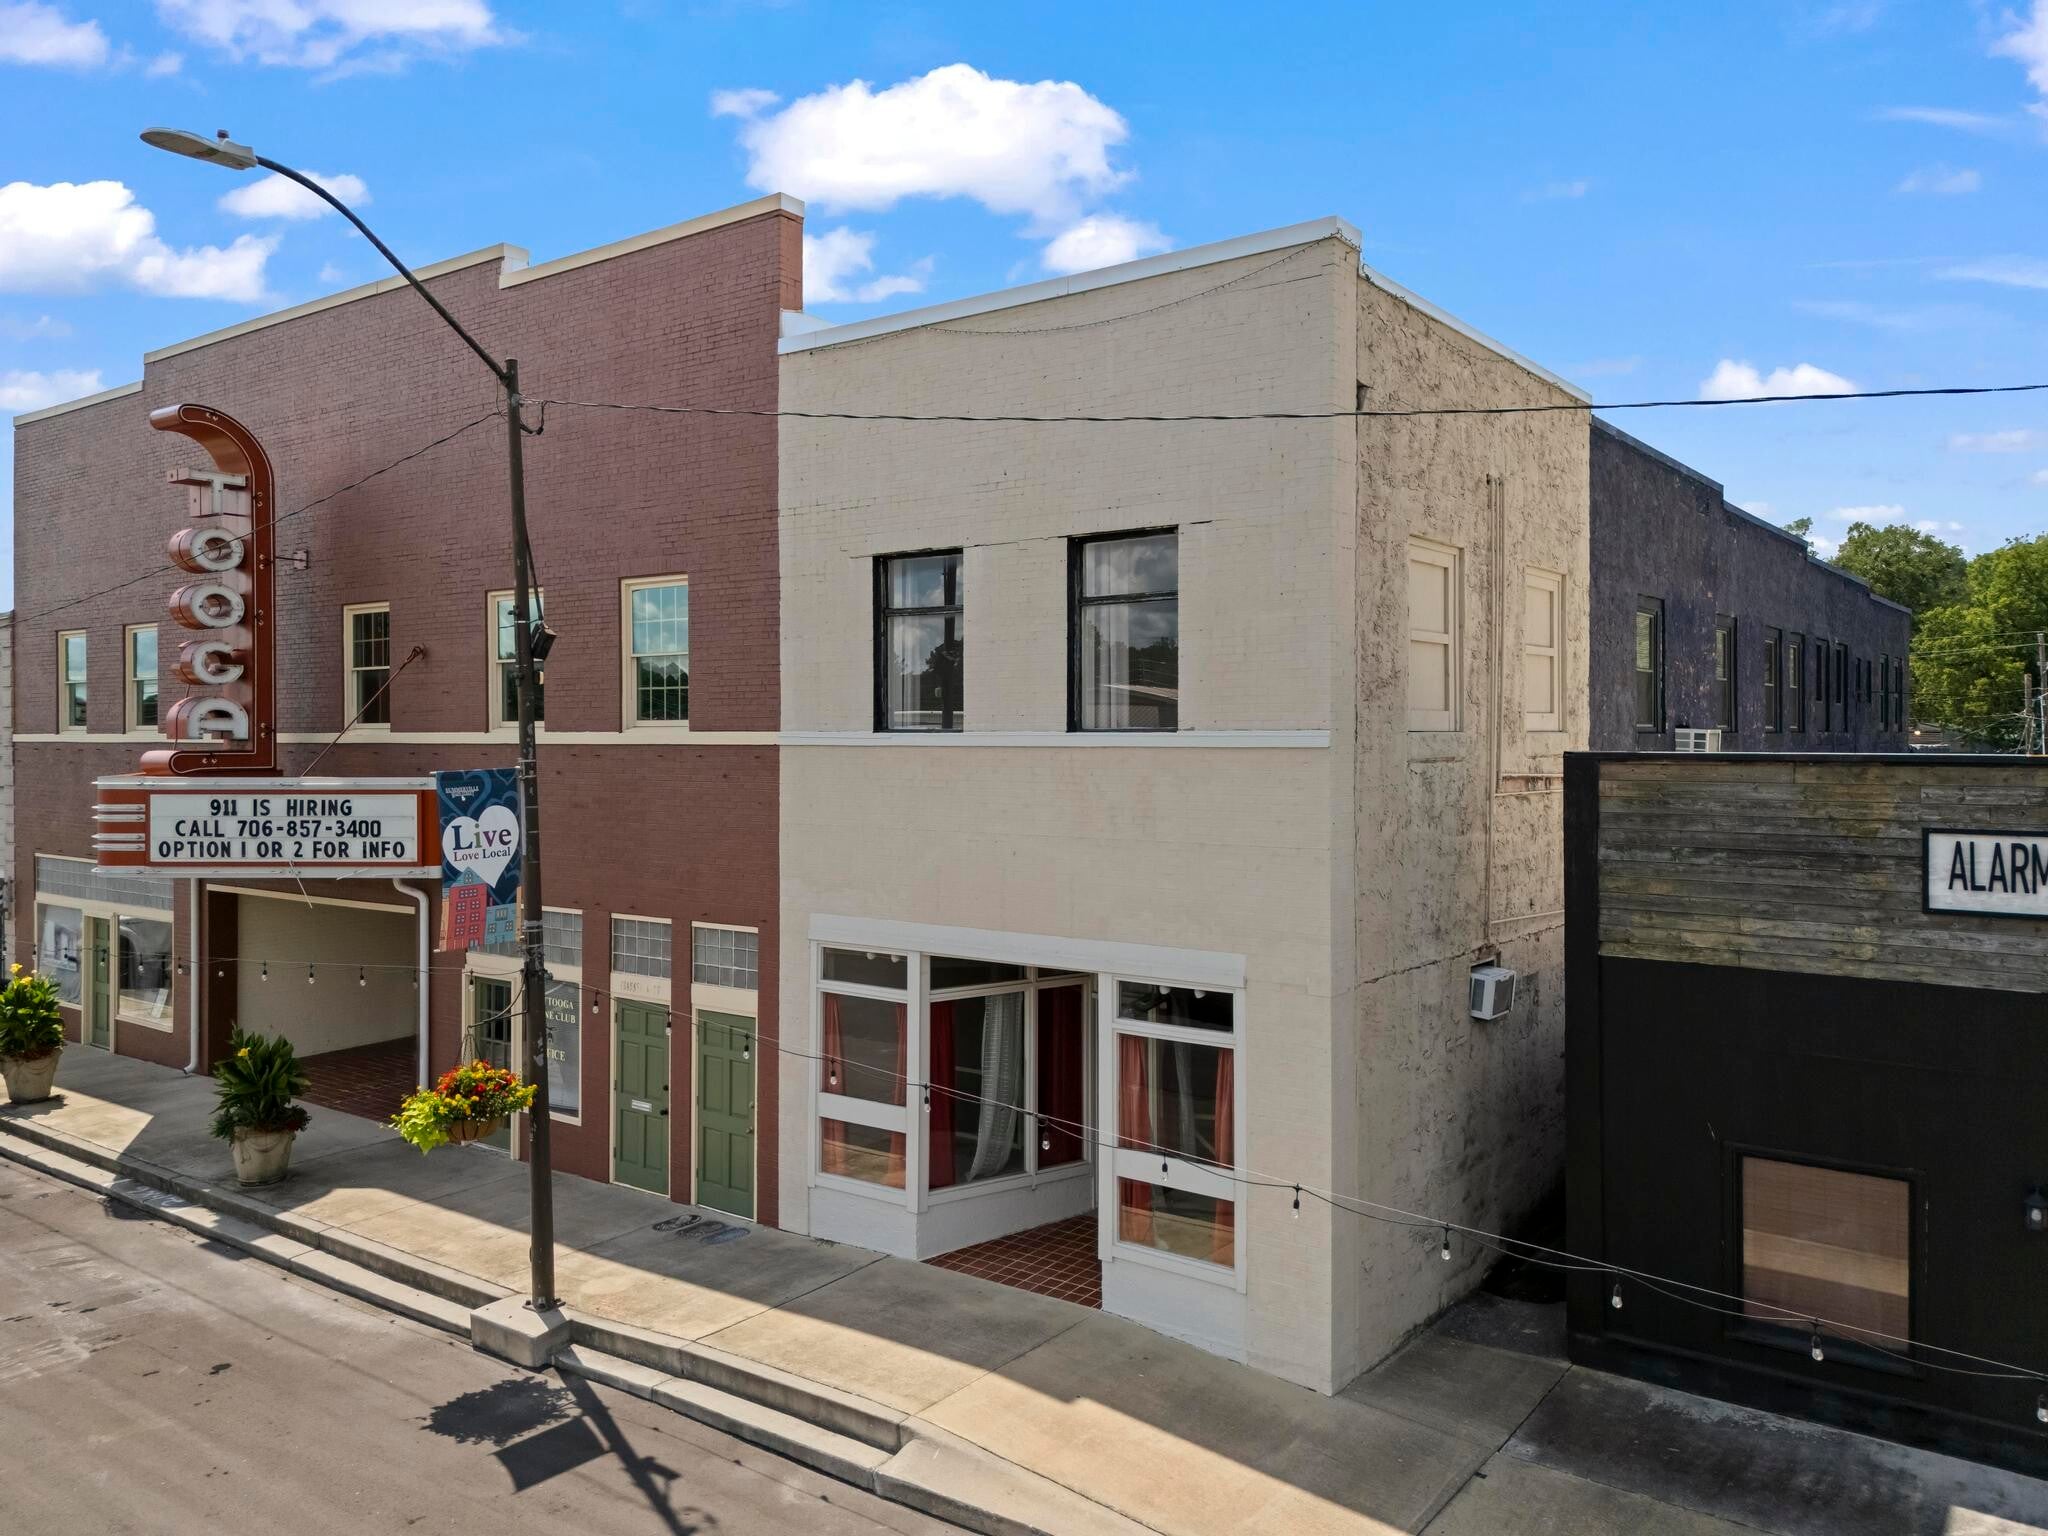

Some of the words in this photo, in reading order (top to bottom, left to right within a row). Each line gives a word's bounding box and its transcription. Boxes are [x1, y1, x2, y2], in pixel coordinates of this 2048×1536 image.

[180, 466, 249, 740] TOOGA
[210, 799, 237, 816] 911
[253, 799, 270, 816] IS
[287, 799, 352, 816] HIRING
[175, 820, 225, 837] CALL
[237, 820, 381, 837] 706-857-3400
[451, 823, 512, 851] Live
[159, 841, 231, 858] OPTION
[256, 841, 283, 858] OR
[293, 841, 303, 858] 2
[313, 841, 350, 858] FOR
[362, 841, 405, 858] INFO
[454, 851, 479, 862] Love
[482, 846, 511, 859] Local
[1948, 840, 2048, 894] ALARM
[556, 1012, 576, 1024] CLUB
